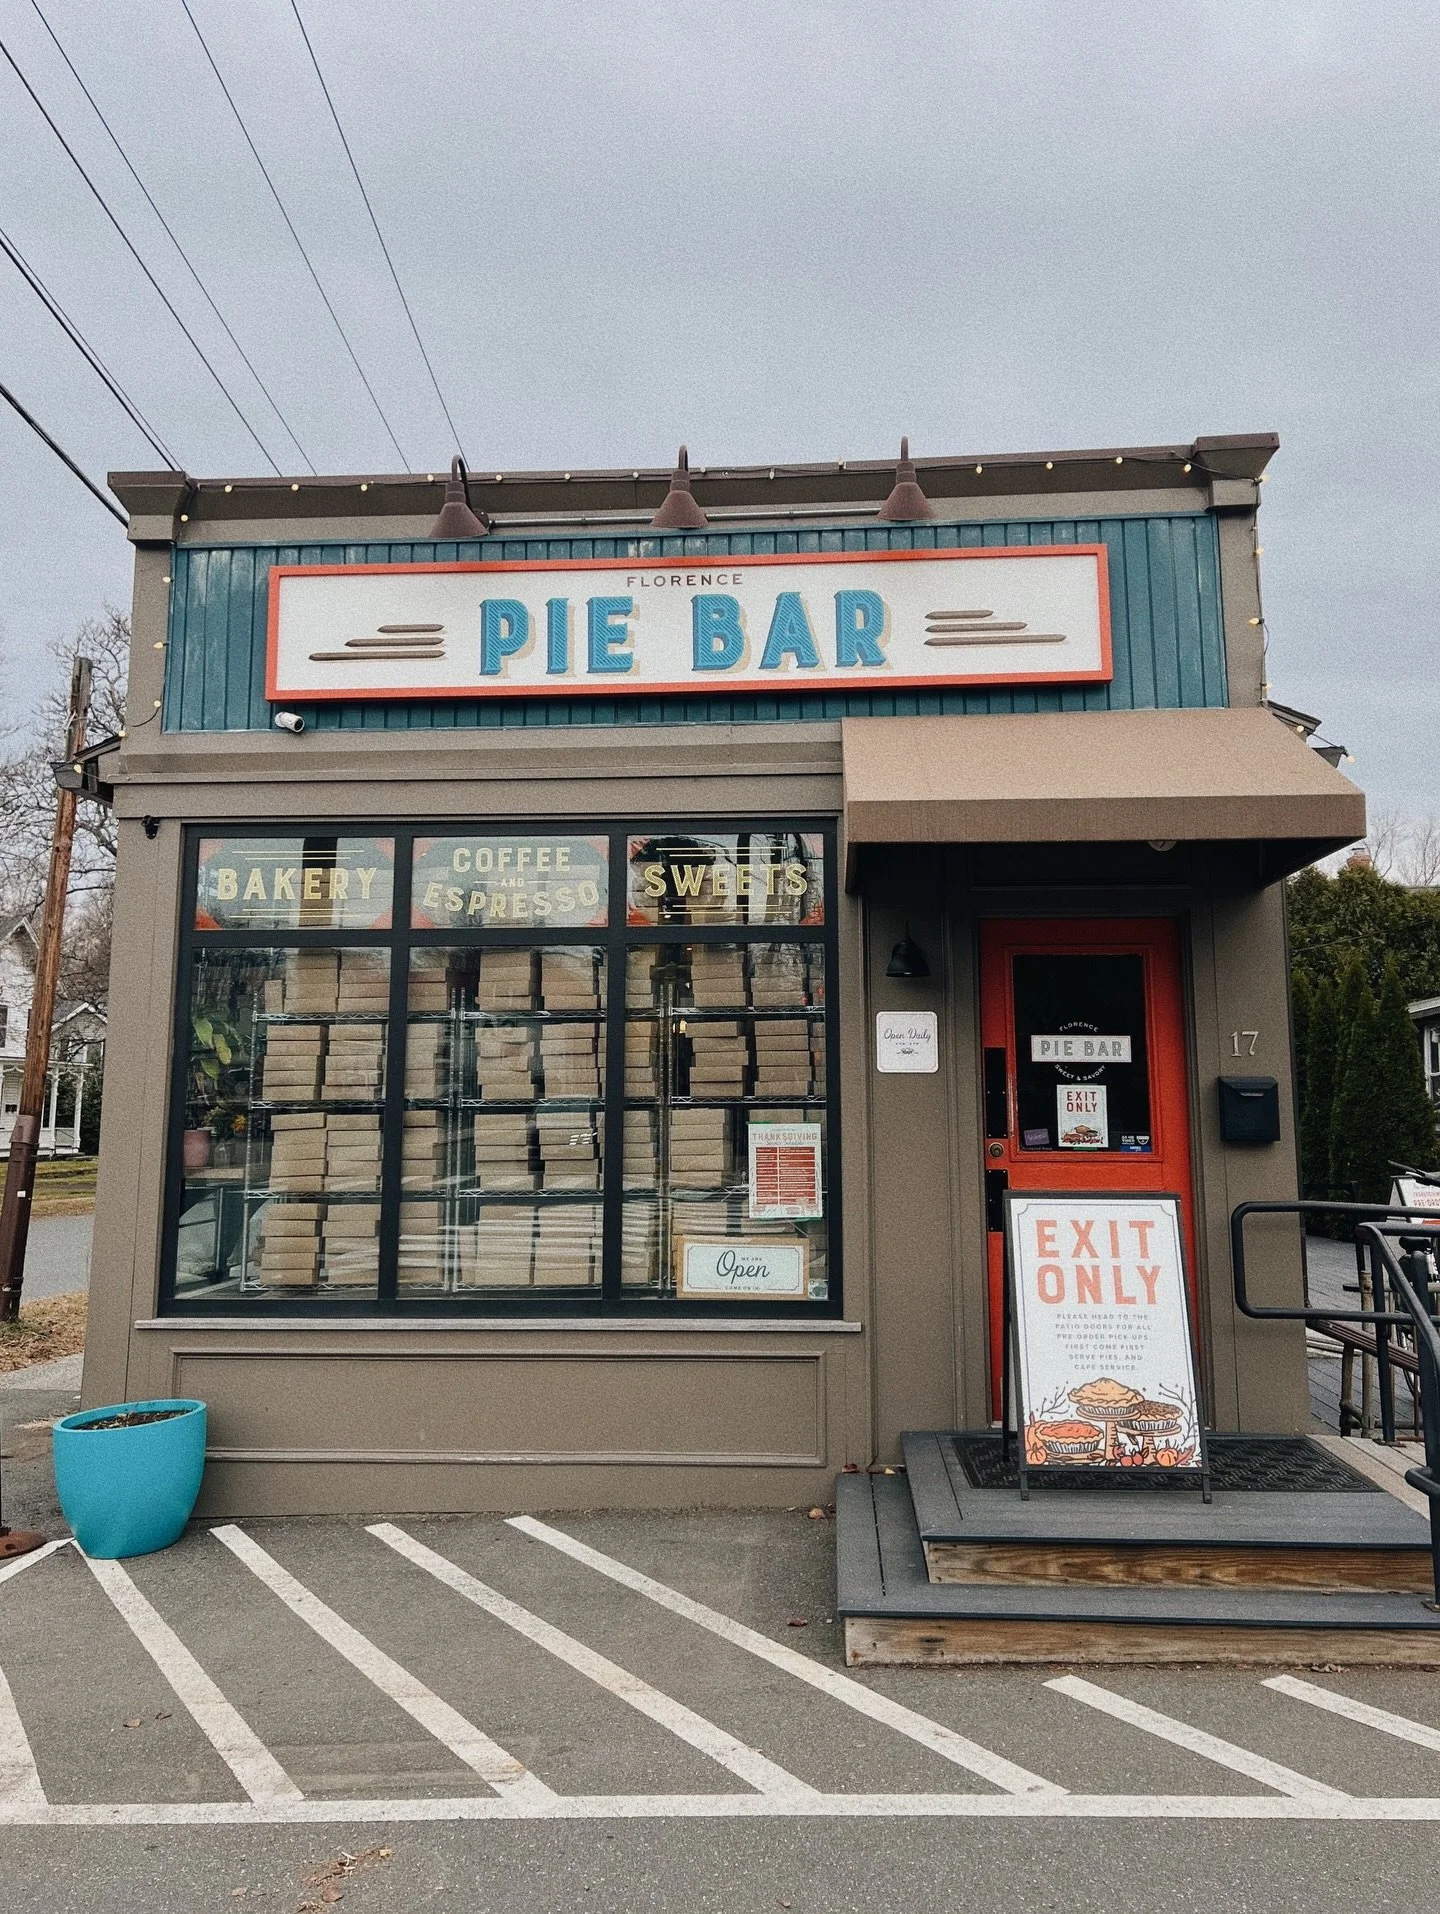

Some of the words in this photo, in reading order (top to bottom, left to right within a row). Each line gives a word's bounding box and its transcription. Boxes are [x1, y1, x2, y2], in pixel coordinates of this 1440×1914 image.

[626, 573, 744, 588] FLORENCE
[479, 595, 641, 679] PIE
[690, 589, 894, 674] BAR
[452, 846, 571, 873] COFFEE
[216, 867, 378, 901] BAKERY
[501, 878, 525, 888] AND
[644, 863, 808, 898] SWEETS
[422, 879, 600, 919] ESPRESSO
[883, 1027, 905, 1042] Open
[908, 1027, 931, 1043] Daily
[1059, 1021, 1099, 1033] FLORENCE
[1040, 1040, 1073, 1057] PIE
[1084, 1041, 1122, 1057] BAR
[1230, 1030, 1259, 1058] 17
[1054, 1064, 1075, 1080] SWEET
[1083, 1065, 1106, 1081] SAVORY
[1066, 1091, 1097, 1102] EXIT
[1066, 1102, 1098, 1113] ONLY
[751, 1132, 818, 1141] THANKSGIVING
[1035, 1219, 1156, 1260] EXIT
[716, 1250, 770, 1285] Open
[1035, 1264, 1162, 1305] ONLY
